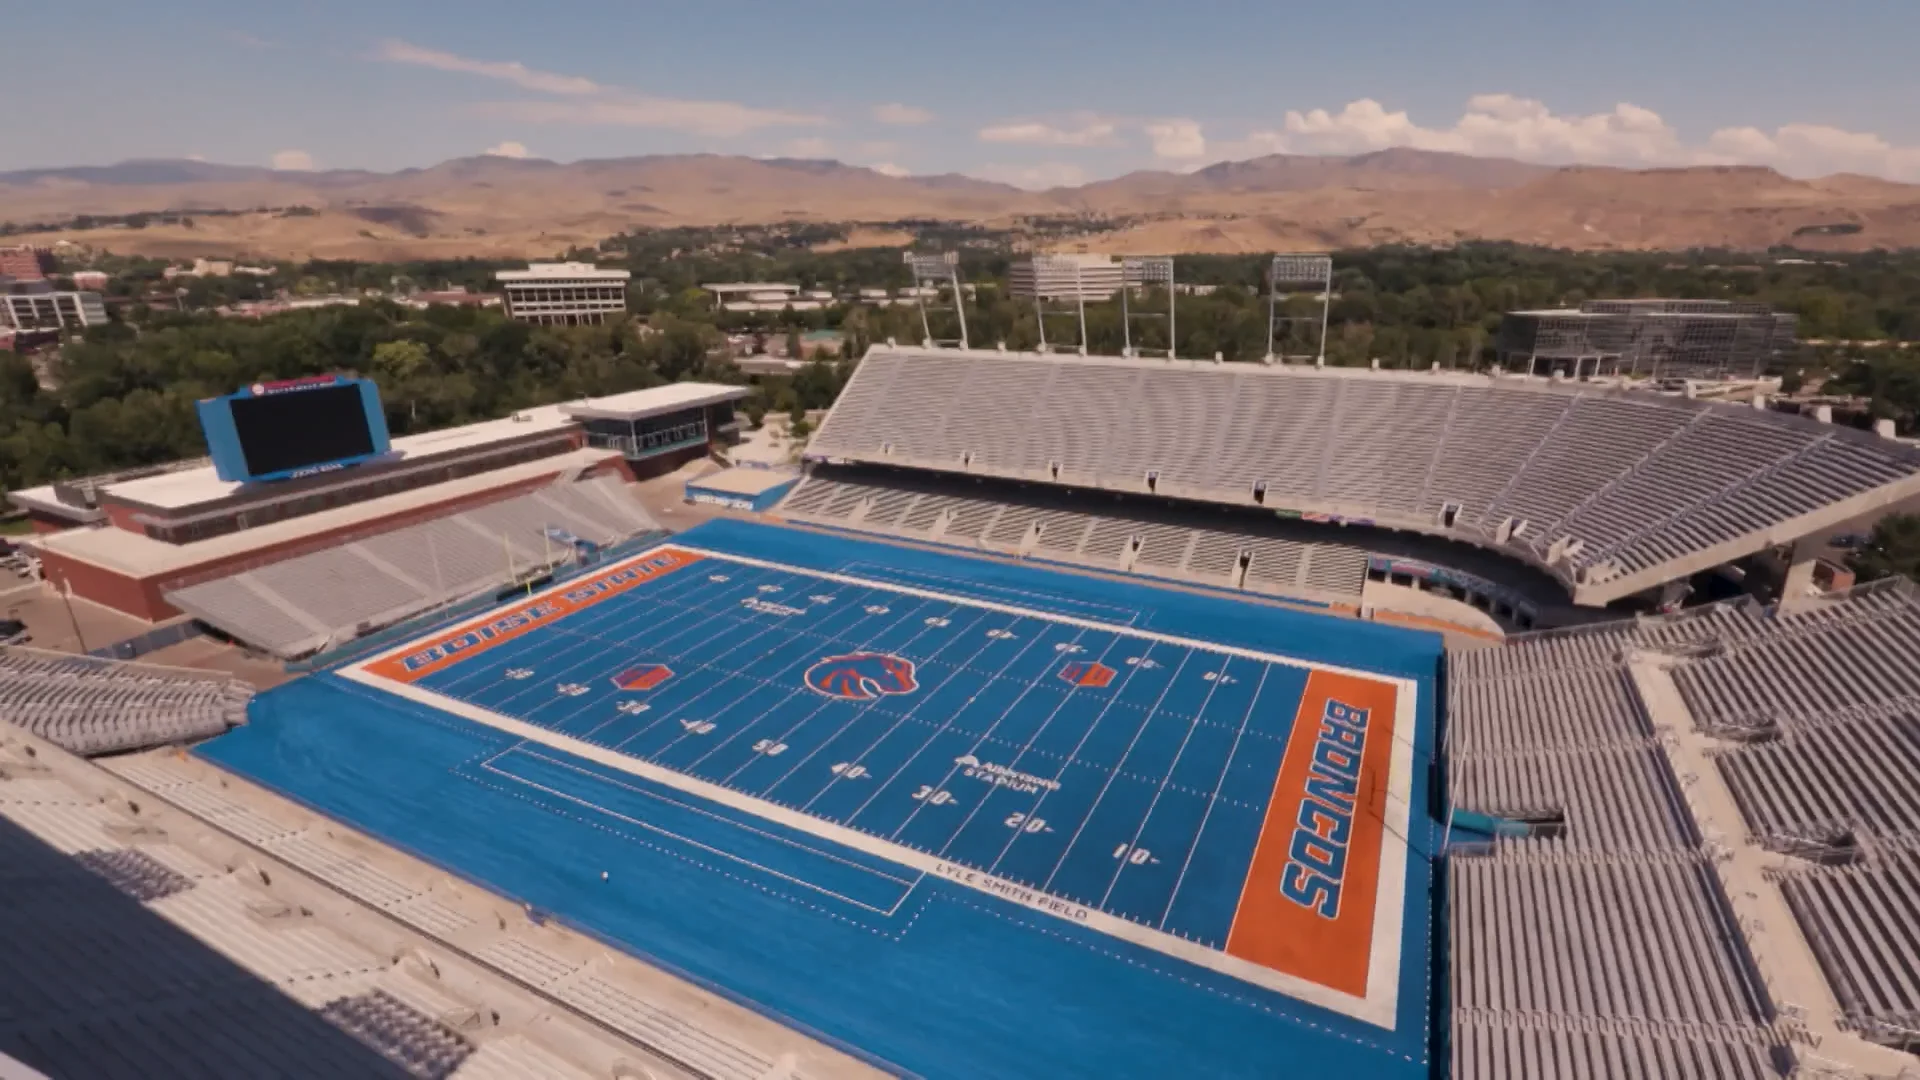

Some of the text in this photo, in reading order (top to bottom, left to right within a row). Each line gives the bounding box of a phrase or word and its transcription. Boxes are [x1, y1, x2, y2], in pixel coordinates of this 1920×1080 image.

[401, 552, 681, 672] BOISE STATE
[912, 784, 953, 806] 30
[1279, 697, 1372, 920] BRONCOS
[1004, 811, 1047, 833] 20
[1112, 843, 1151, 865] 10
[936, 863, 1088, 920] LYLE SMITH FIELD
